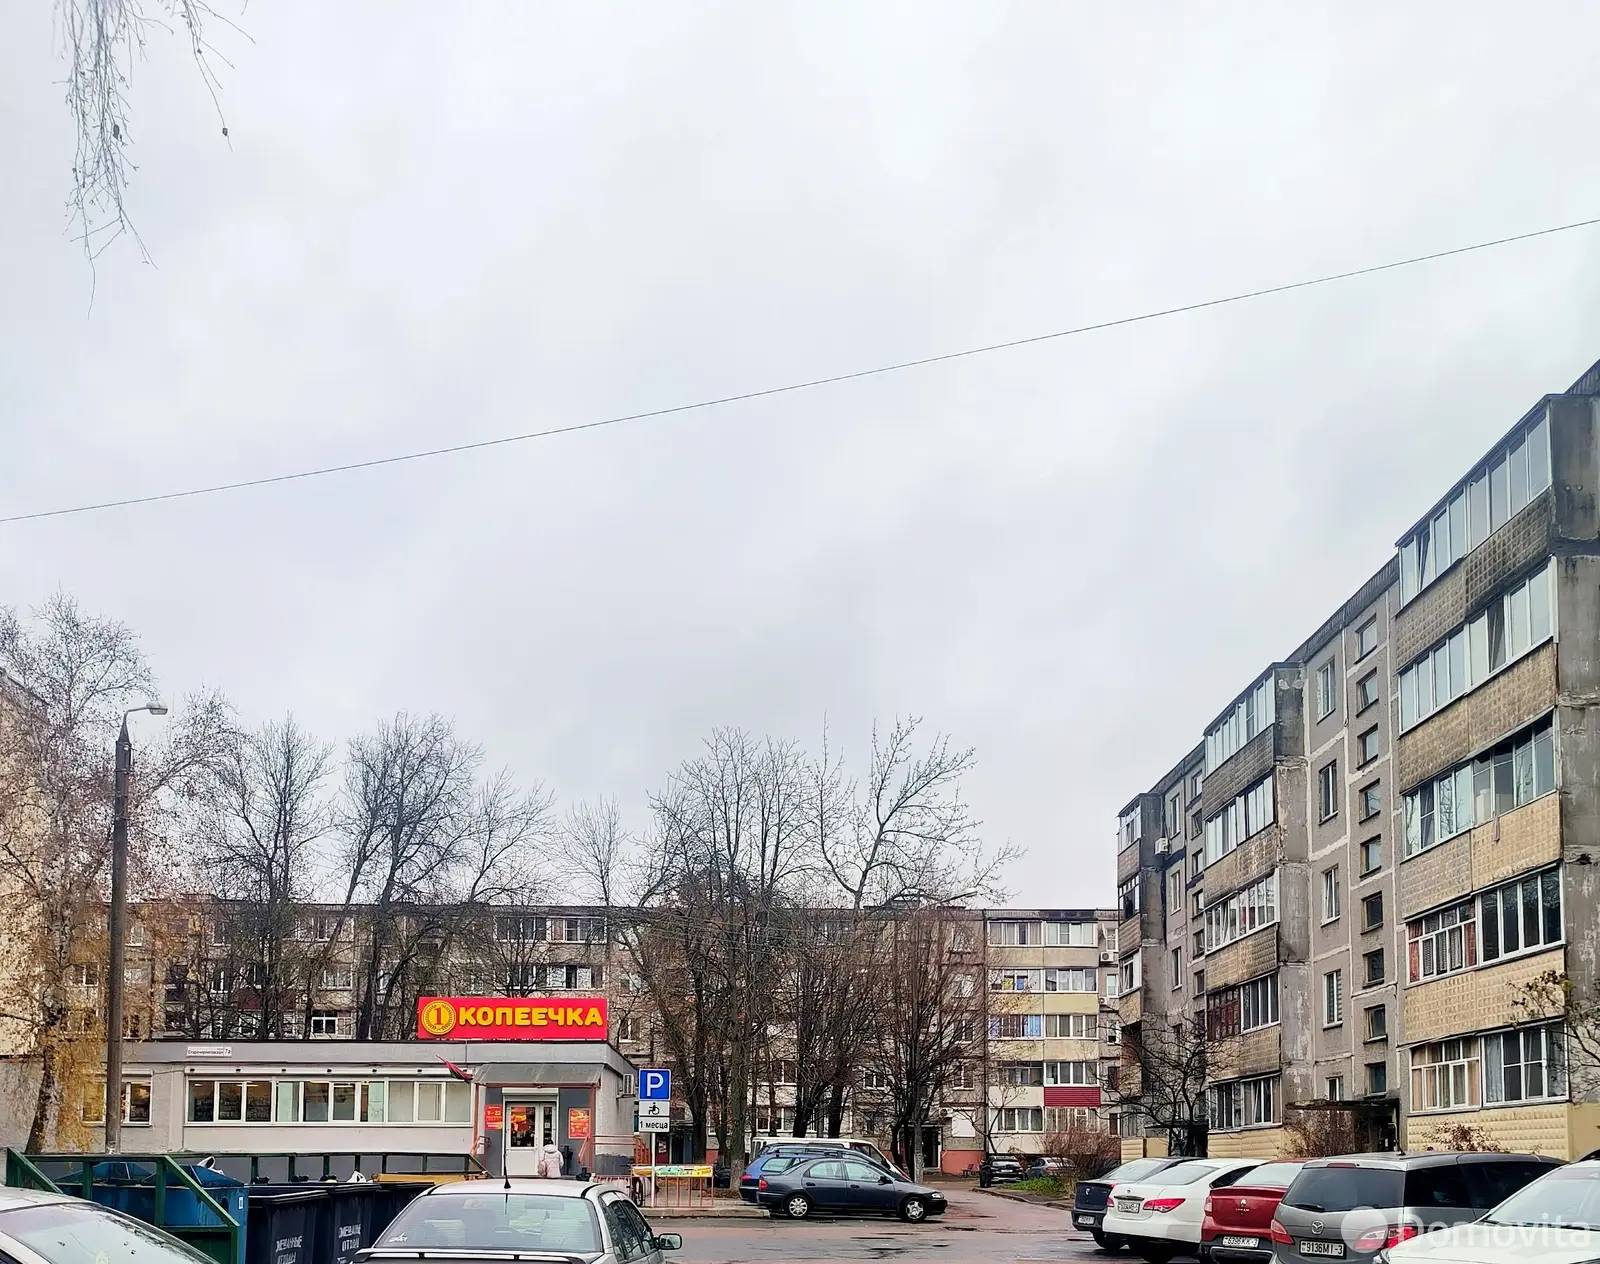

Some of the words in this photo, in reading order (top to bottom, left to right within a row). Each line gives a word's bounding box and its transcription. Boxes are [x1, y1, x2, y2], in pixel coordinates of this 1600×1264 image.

[433, 1008, 443, 1026] 1
[459, 1006, 603, 1026] КОПЕЕЧКА
[646, 1072, 664, 1097] P
[640, 1120, 644, 1129] 1
[646, 1122, 669, 1130] месца
